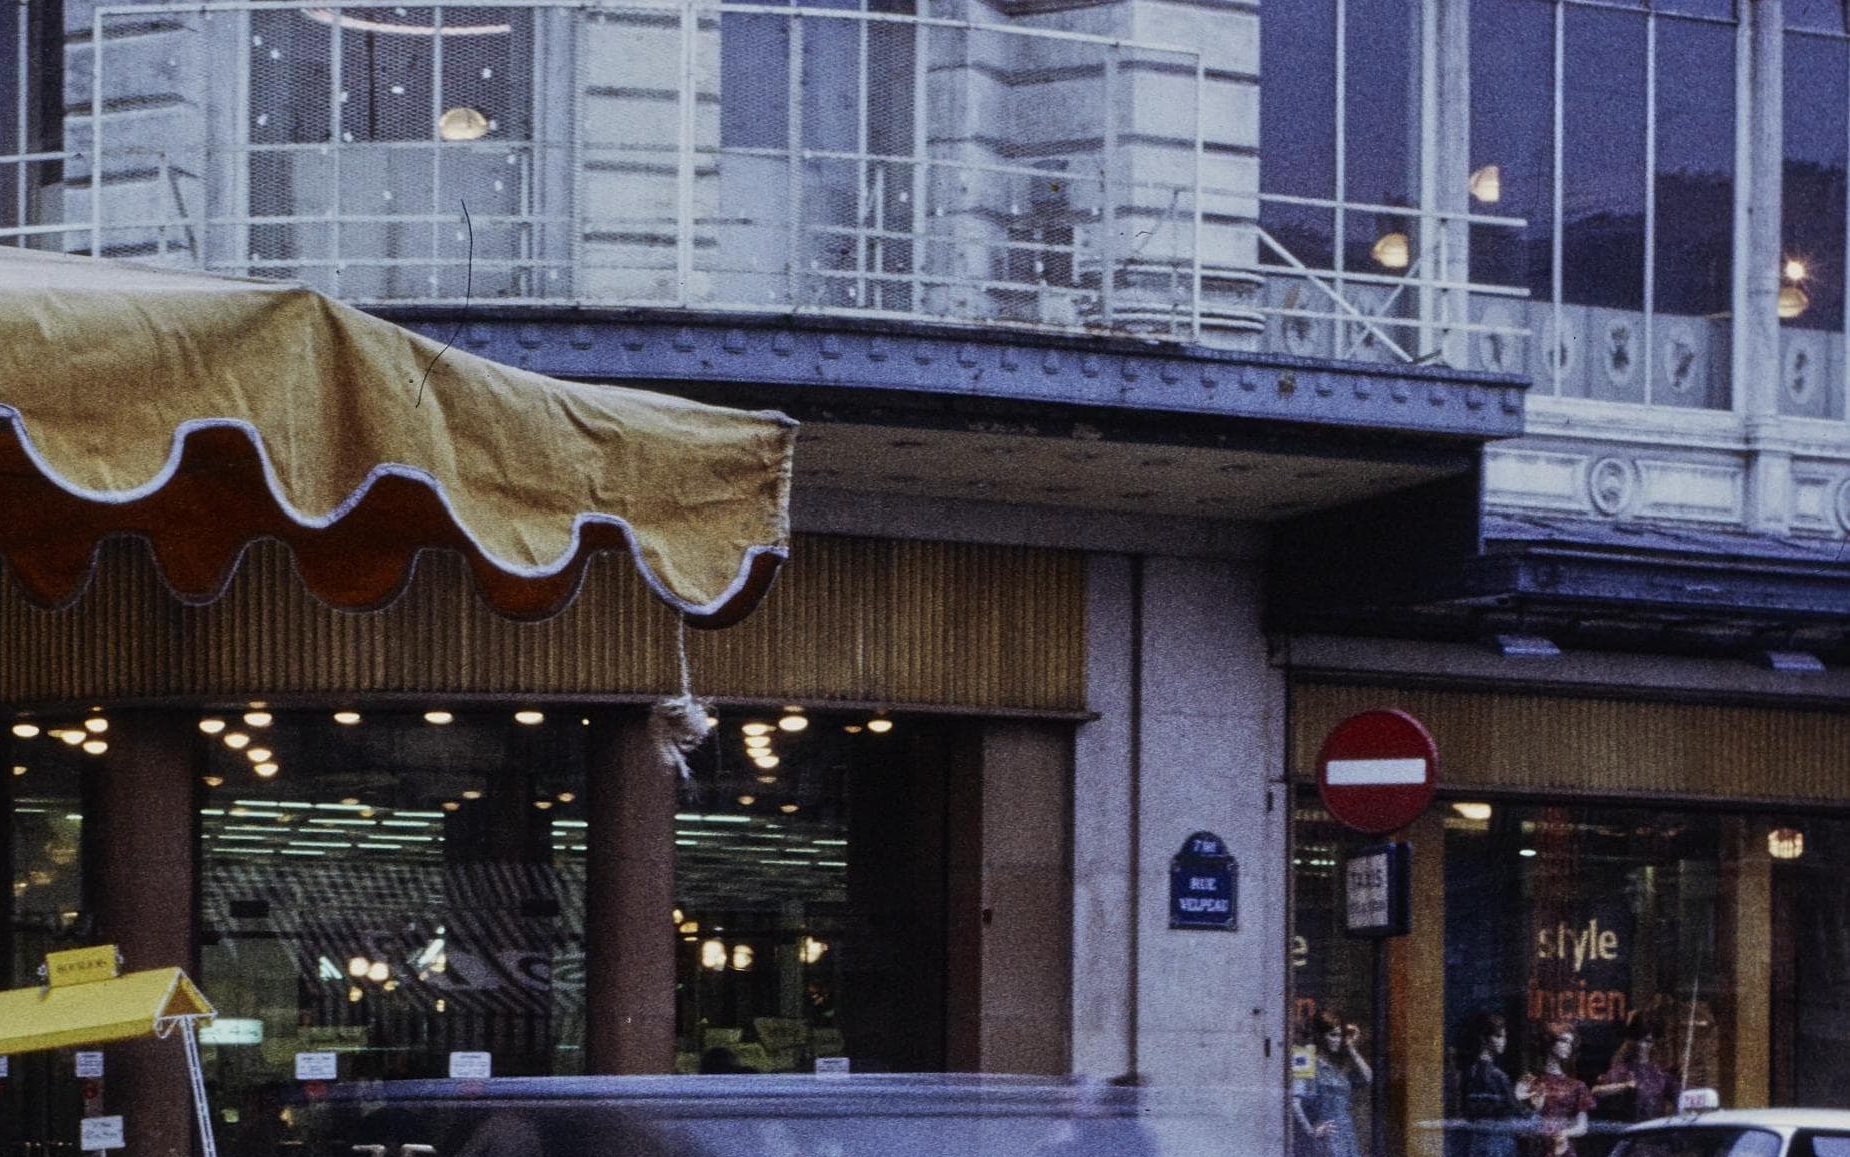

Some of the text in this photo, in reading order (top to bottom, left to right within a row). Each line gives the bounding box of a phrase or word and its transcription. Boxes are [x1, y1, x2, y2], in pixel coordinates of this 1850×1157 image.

[1188, 877, 1217, 891] RUE
[1178, 898, 1229, 912] VELPEAU
[1538, 919, 1618, 972] style
